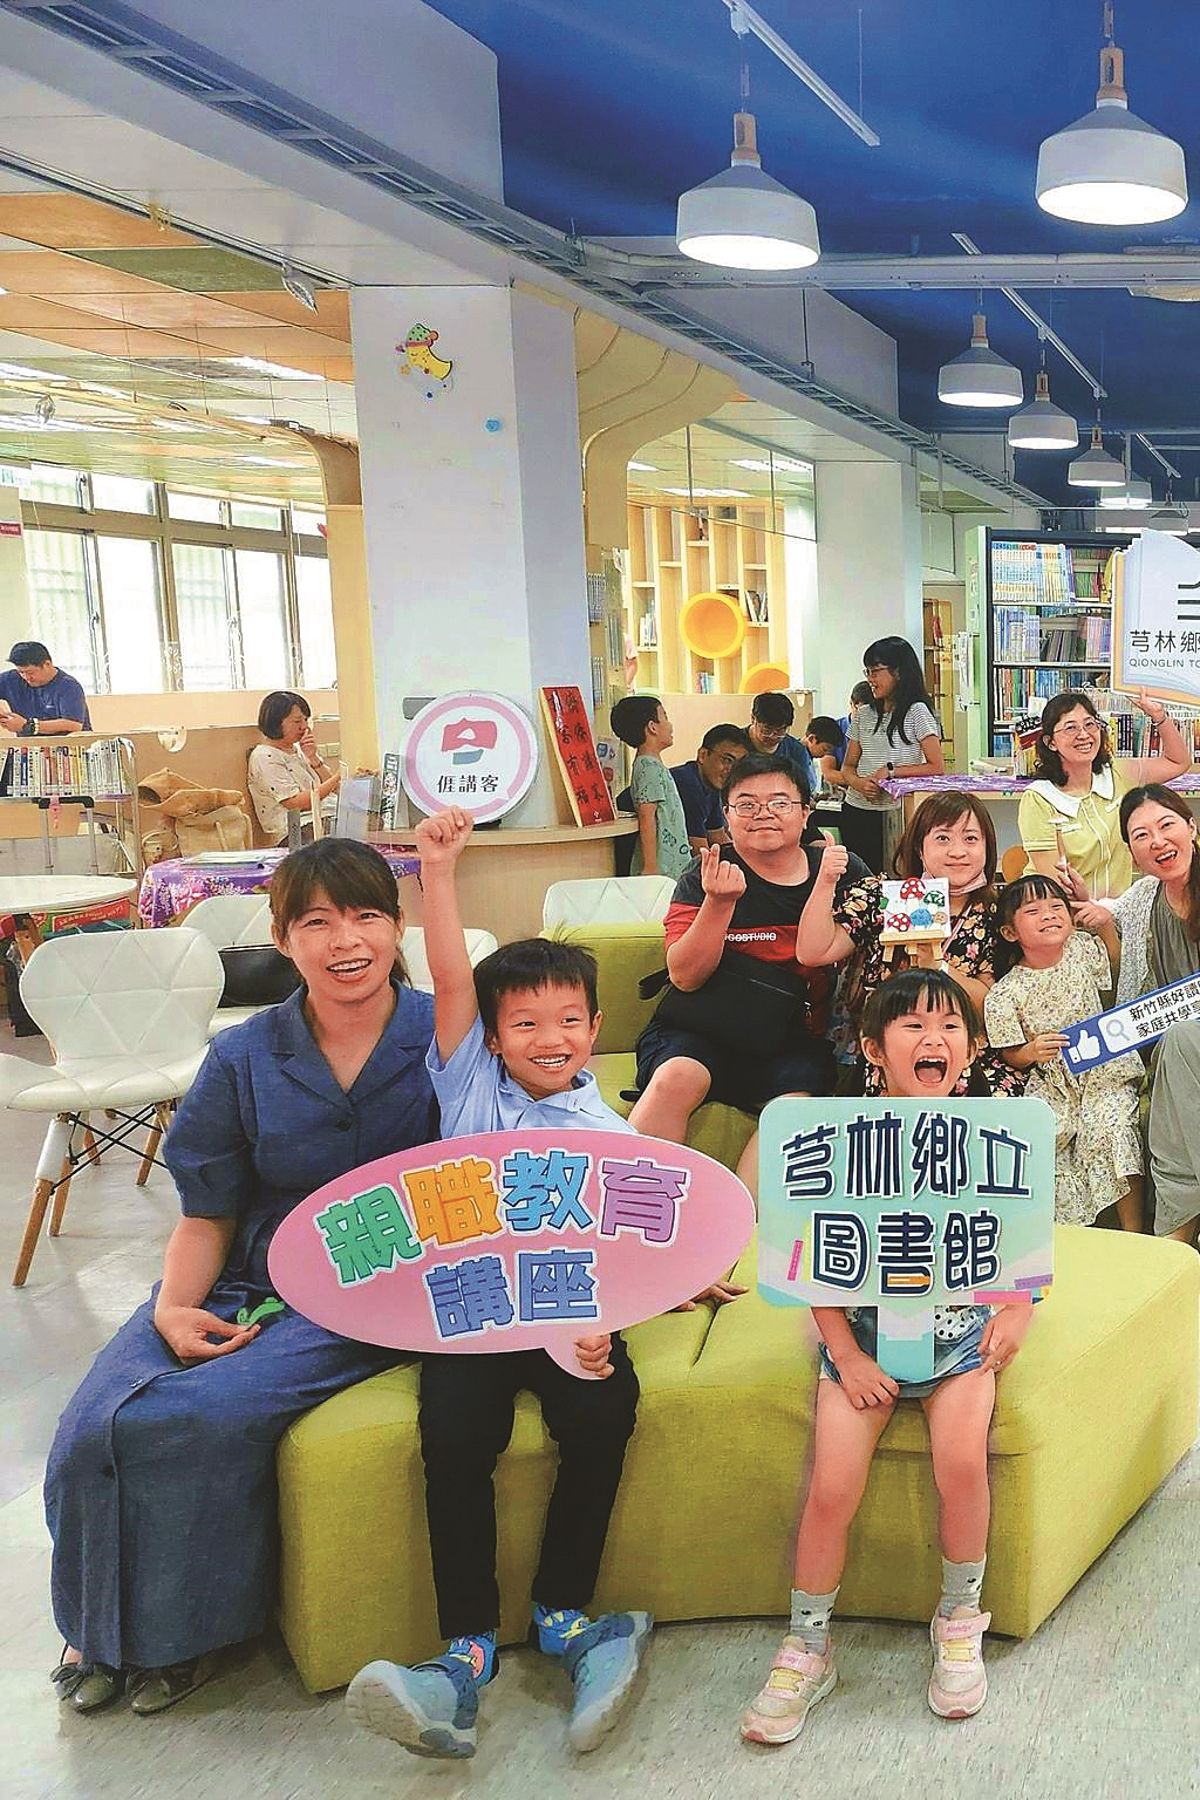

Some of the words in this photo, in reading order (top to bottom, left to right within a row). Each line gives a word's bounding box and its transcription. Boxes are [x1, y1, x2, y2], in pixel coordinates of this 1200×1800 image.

[1129, 658, 1184, 668] QIONGLIN
[781, 1111, 1032, 1200] 芎林鄉立
[317, 1150, 689, 1284] 親職教育
[812, 1211, 1002, 1296] 圖書館
[425, 1248, 600, 1338] 講座
